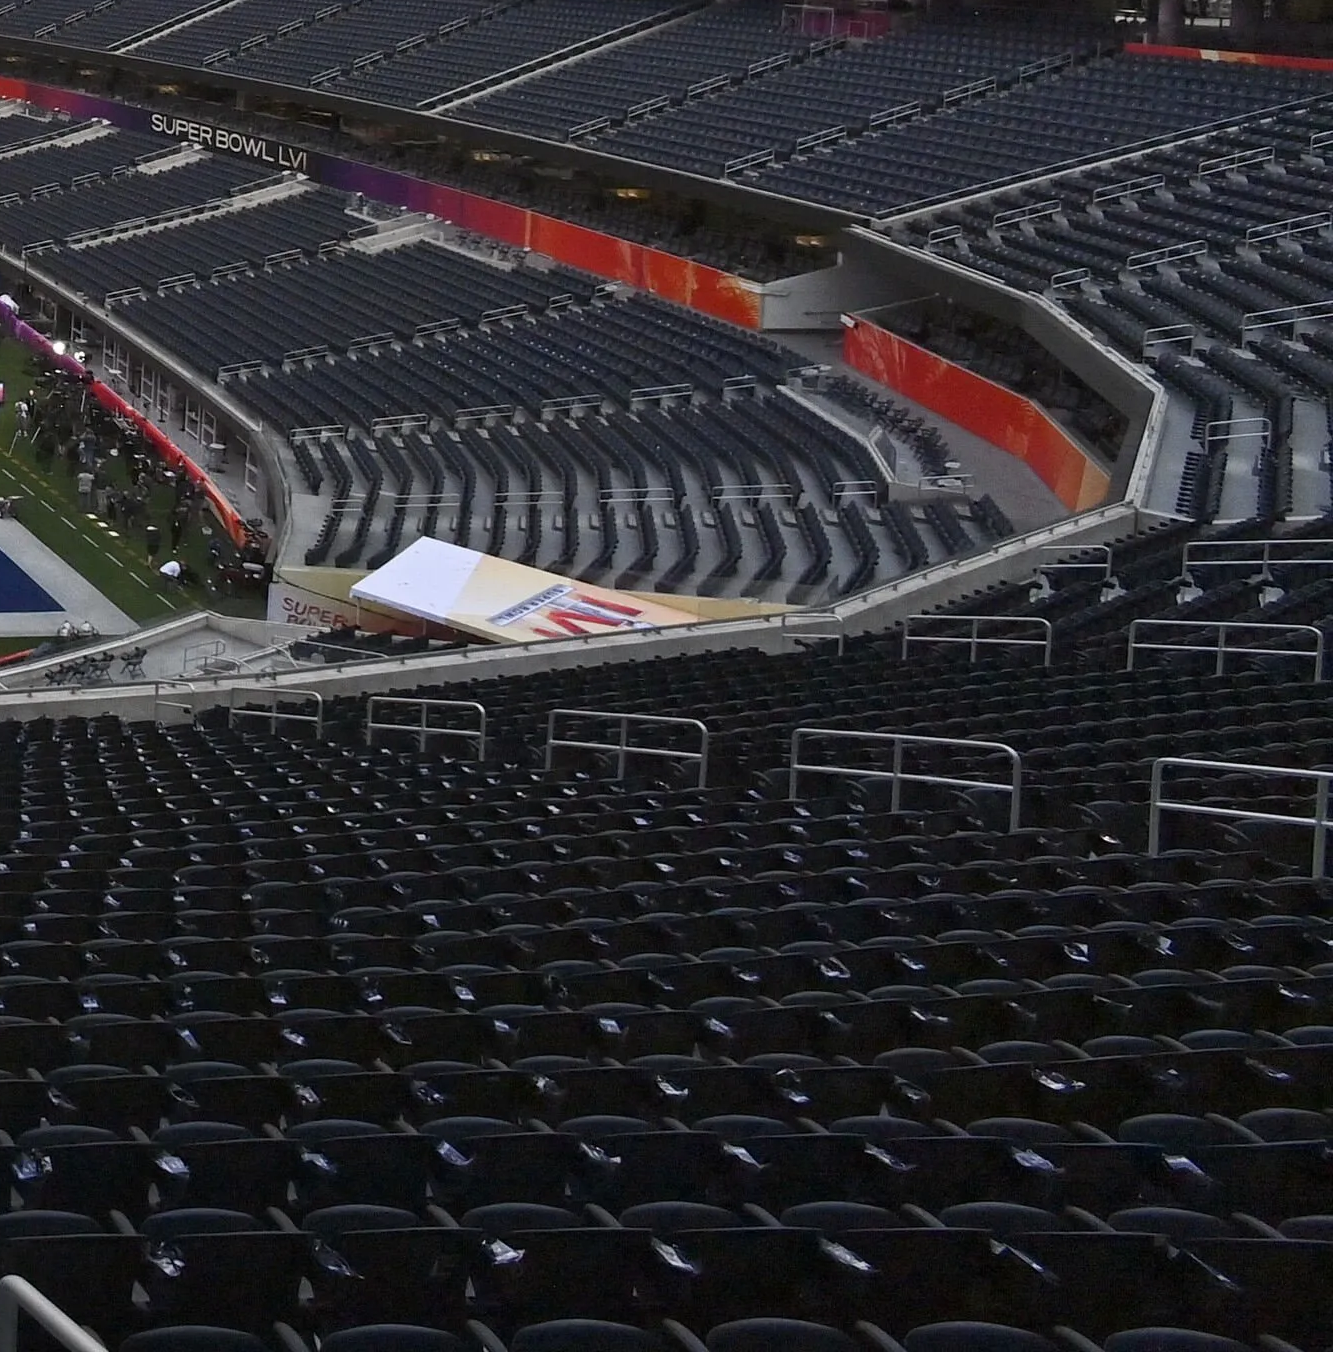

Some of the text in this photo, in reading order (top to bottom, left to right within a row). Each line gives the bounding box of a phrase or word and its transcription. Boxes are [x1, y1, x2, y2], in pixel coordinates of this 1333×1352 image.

[151, 114, 307, 171] SUPER BOWL LVI
[282, 597, 348, 626] SUPER
